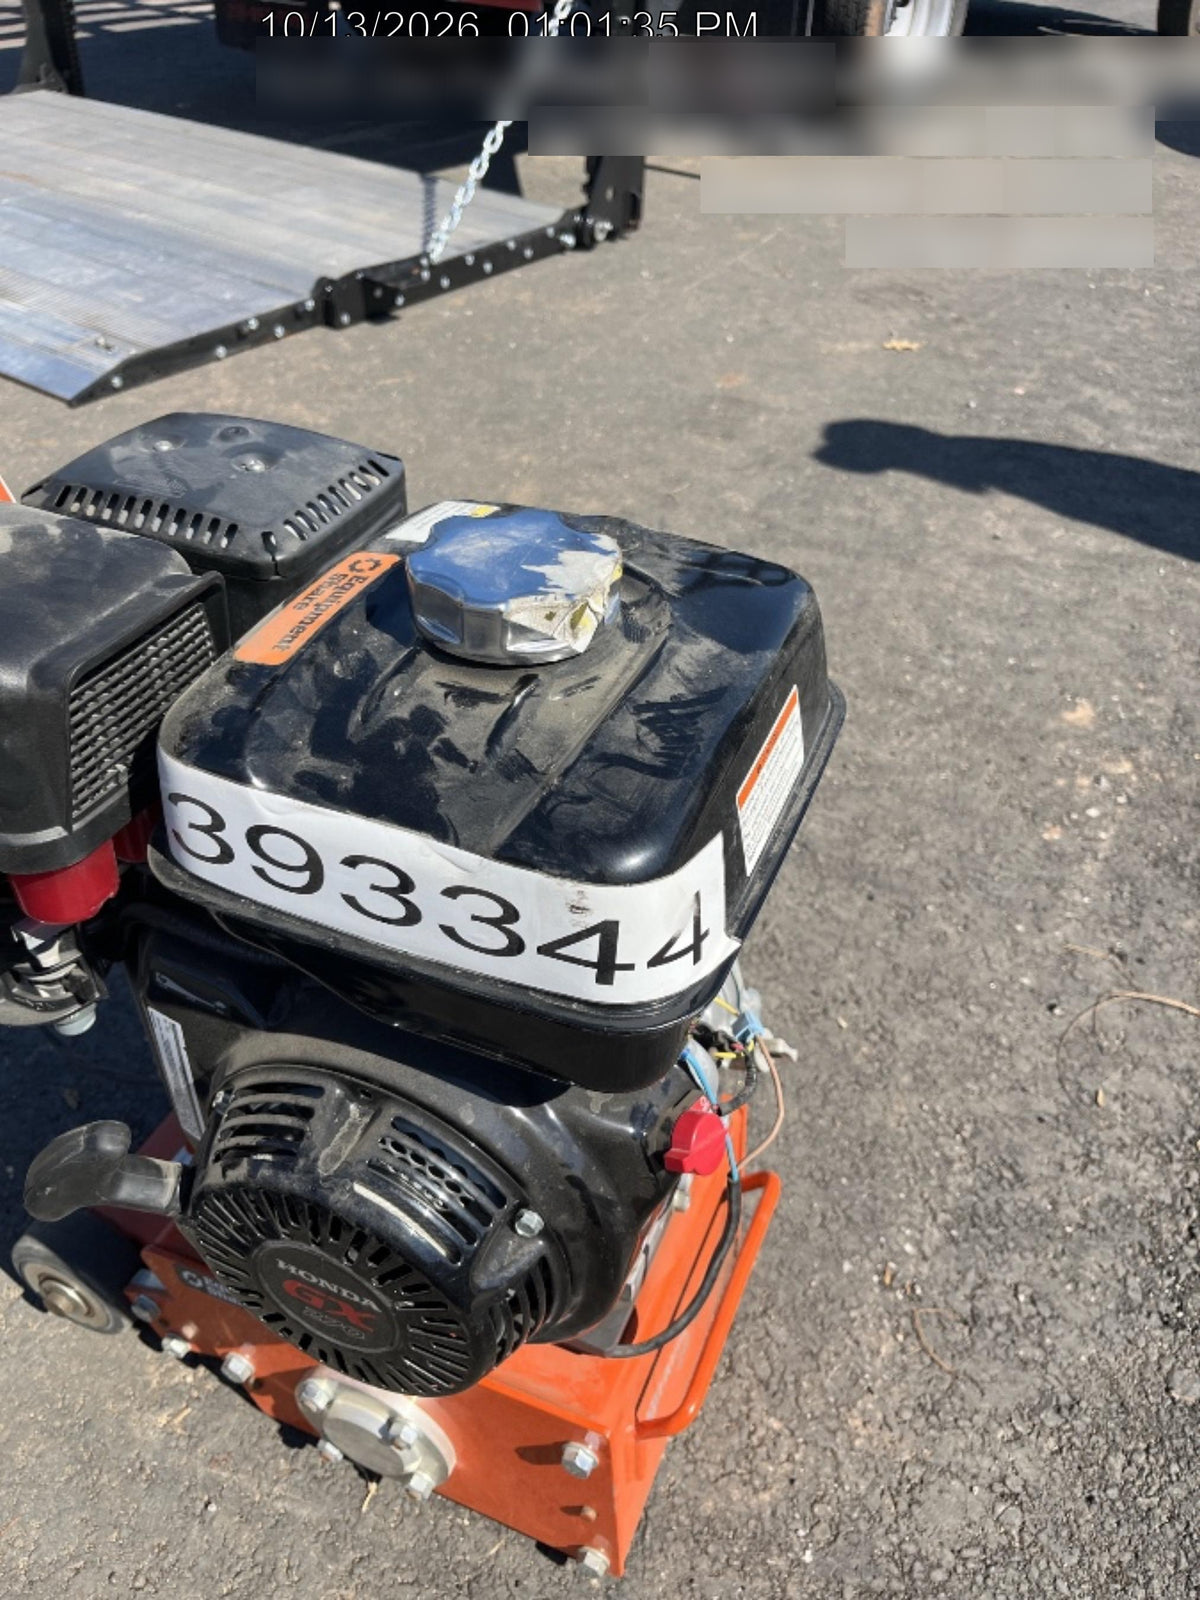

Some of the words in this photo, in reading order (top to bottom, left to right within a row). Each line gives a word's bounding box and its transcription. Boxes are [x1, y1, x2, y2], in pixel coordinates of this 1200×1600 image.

[272, 574, 369, 652] Equipment
[293, 572, 349, 611] Share
[167, 792, 710, 986] 393344
[276, 1258, 382, 1312] HONDA
[283, 1279, 377, 1335] GX
